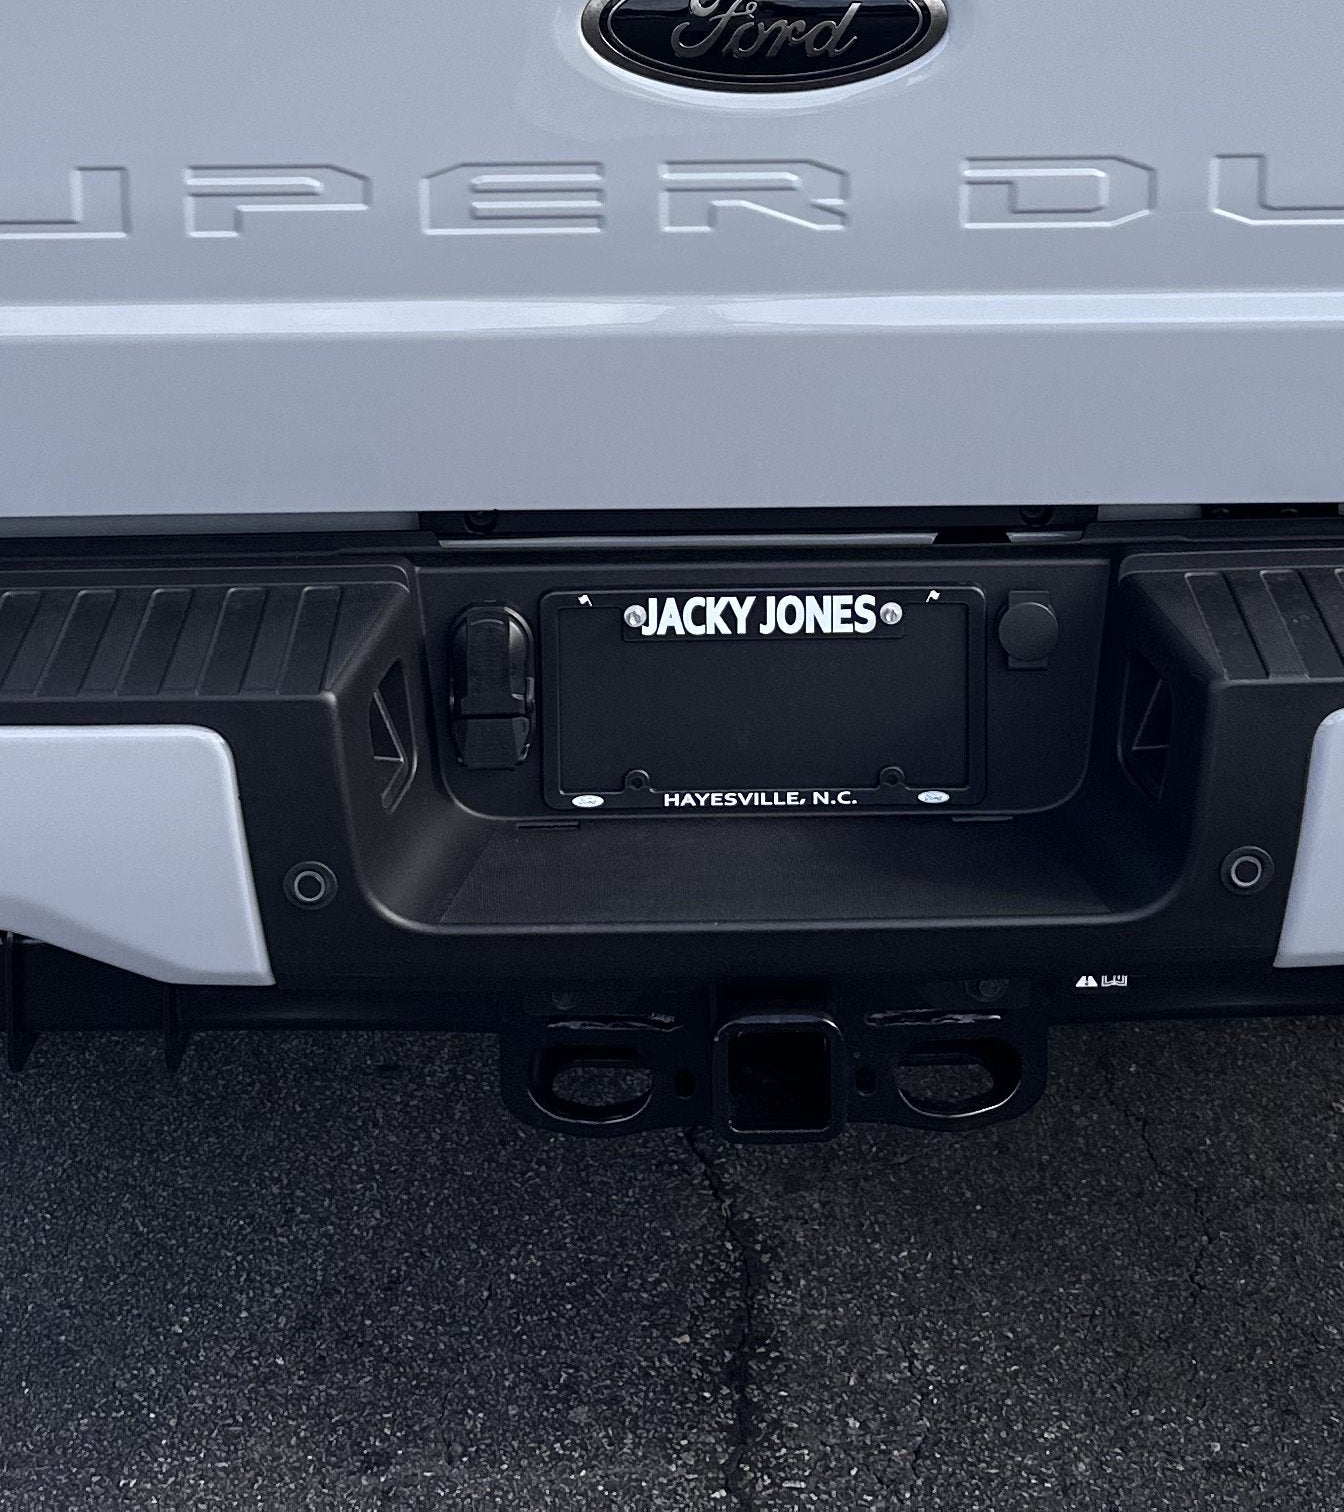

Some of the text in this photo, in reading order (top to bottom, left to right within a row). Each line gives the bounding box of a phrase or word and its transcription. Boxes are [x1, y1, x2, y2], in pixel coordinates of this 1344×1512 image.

[641, 593, 877, 637] JACKY JONES
[663, 790, 859, 807] HAYESVILLE, N.C.
